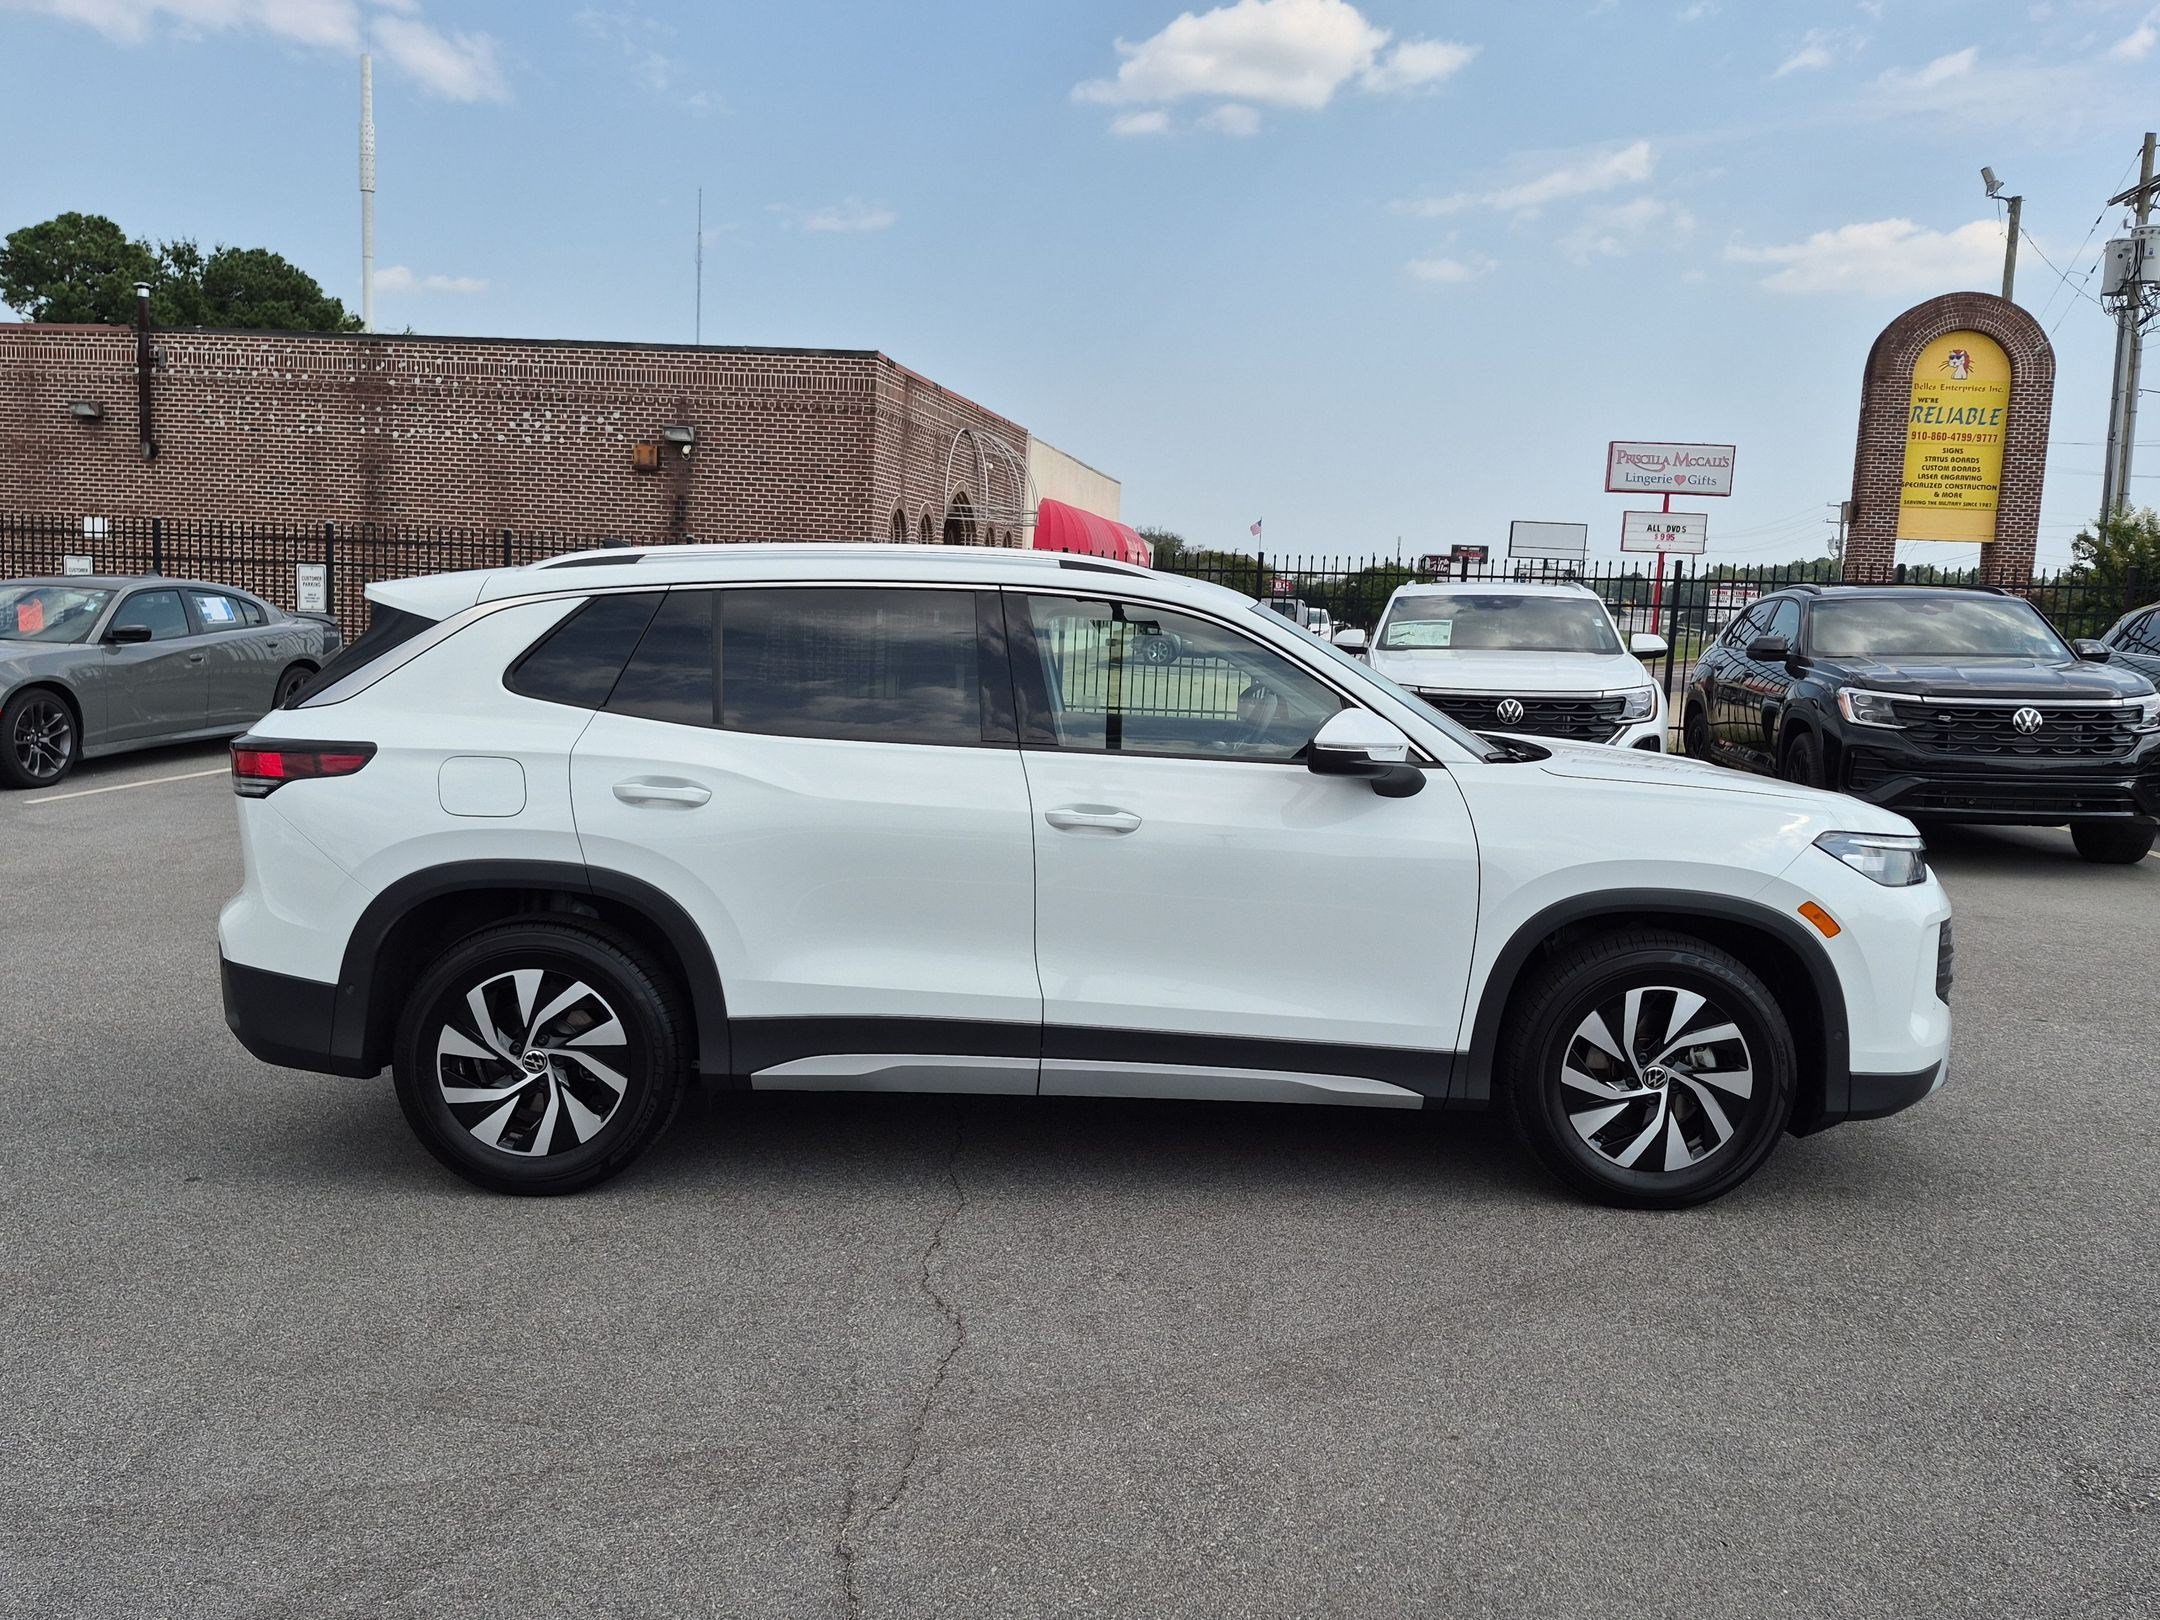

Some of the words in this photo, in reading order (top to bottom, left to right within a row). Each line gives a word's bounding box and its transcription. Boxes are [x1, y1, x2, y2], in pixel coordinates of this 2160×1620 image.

[1940, 383, 1986, 393] Enterprises
[1910, 405, 2002, 426] RELIABLE
[1911, 431, 1998, 443] 910-860-4799/9777
[1616, 449, 1670, 472] PRISCILLA
[1625, 472, 1673, 486] Lingerie
[1687, 474, 1717, 486] Gifts
[1901, 481, 1942, 489] SPECIALIZED
[1945, 483, 1998, 491] CONSTRUCTION
[1646, 524, 1660, 532] ALL
